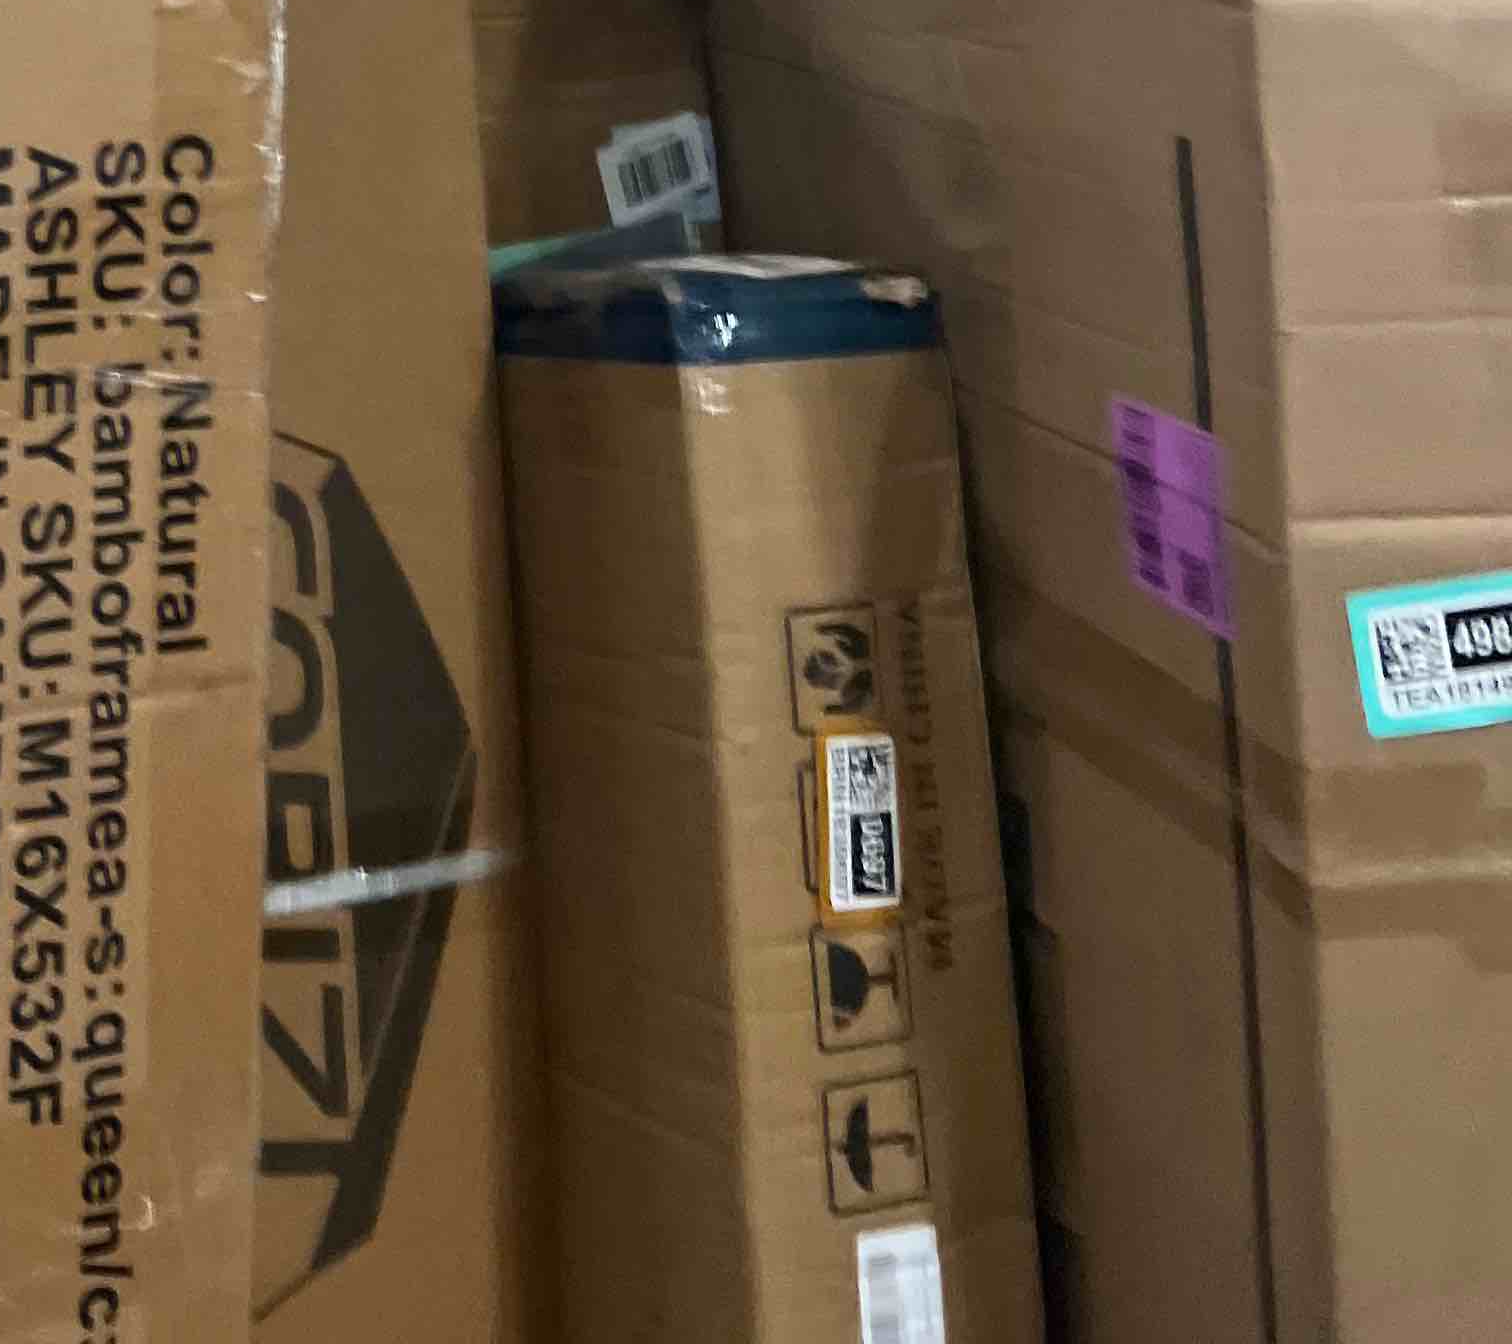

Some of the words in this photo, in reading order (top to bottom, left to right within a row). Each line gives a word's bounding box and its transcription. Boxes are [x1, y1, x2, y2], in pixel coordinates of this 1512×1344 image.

[21, 145, 80, 473] ASHLEY
[92, 138, 147, 331] SKU:
[159, 132, 215, 363] Color:
[17, 503, 76, 700] SKU:
[155, 379, 215, 656] Natural
[1451, 612, 1512, 660] 498
[8, 715, 72, 1127] M16X532F
